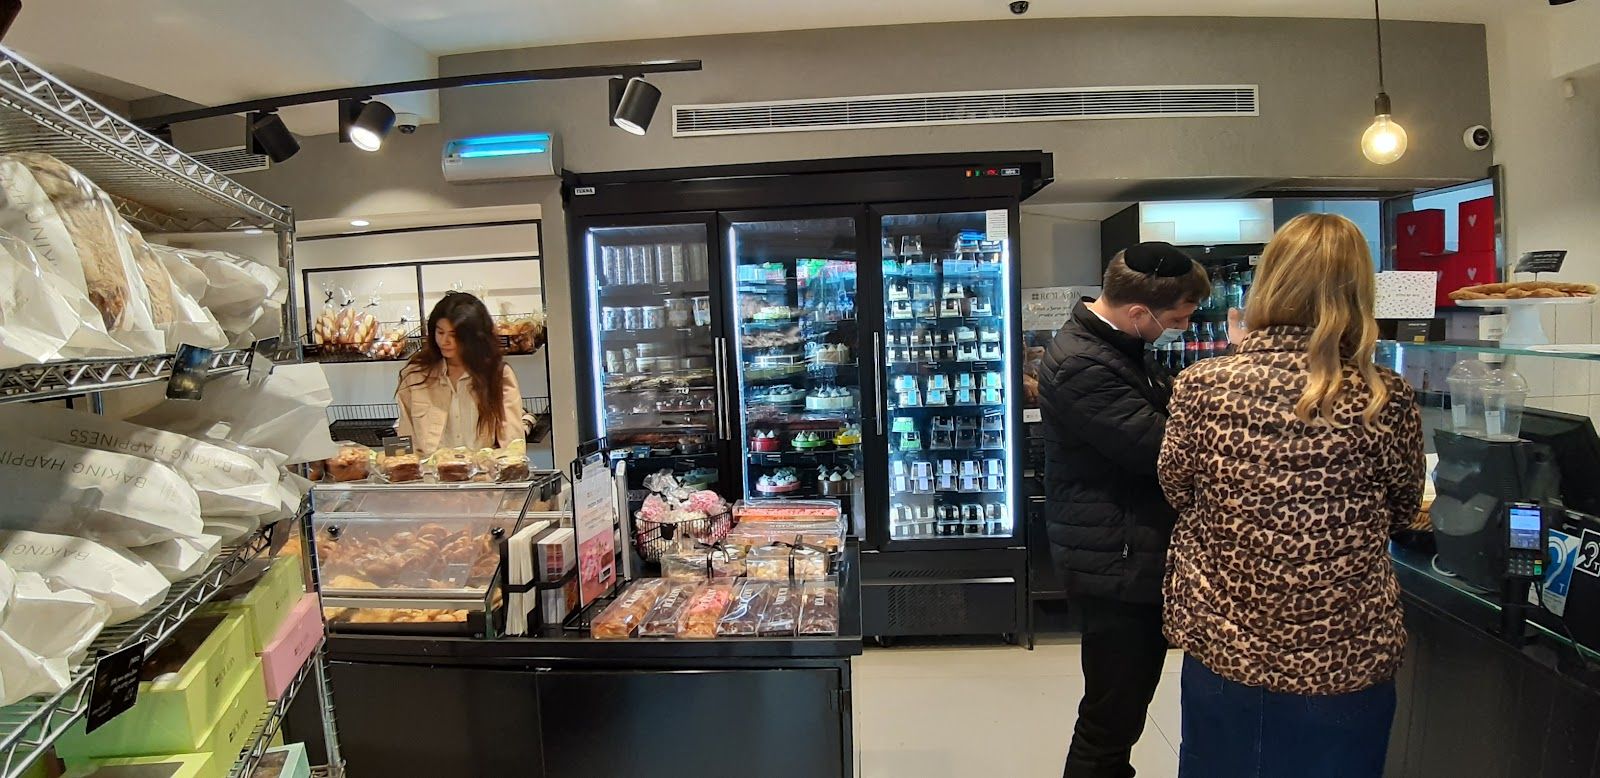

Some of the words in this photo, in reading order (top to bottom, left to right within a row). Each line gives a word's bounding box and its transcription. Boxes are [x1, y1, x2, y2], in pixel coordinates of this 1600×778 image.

[69, 428, 164, 456] HAPPINESS
[171, 449, 233, 474] BAKING
[72, 463, 147, 488] BAKING
[14, 544, 90, 562] BAKING
